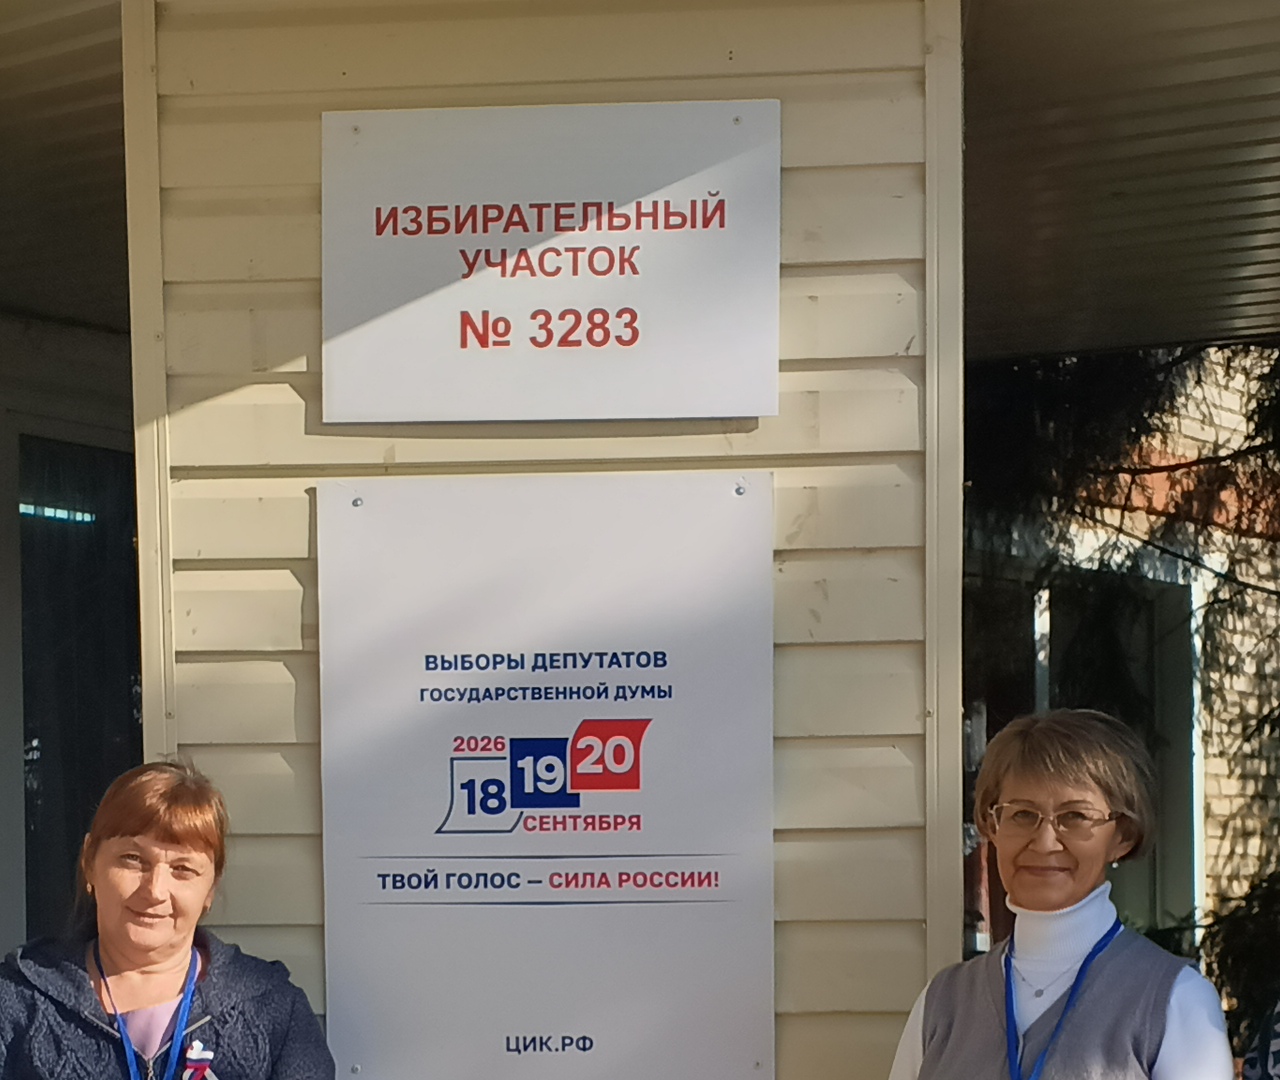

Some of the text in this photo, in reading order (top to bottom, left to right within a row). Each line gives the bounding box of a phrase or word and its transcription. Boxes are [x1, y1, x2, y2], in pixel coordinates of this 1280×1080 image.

[375, 190, 726, 236] ИЗБИРАТЕЛЬНЫЙ
[459, 245, 641, 279] УЧАСТОК
[460, 307, 640, 349] № 3283
[424, 650, 668, 672] ВЫБОРЫ ДЕПУТАТОВ
[420, 682, 673, 703] ГОСУДАРСТВЕННОЙ ДУМЫ
[452, 735, 506, 753] 2026
[460, 735, 635, 816] 18 19 20
[522, 814, 642, 832] СЕНТЯБРЯ
[377, 868, 438, 890] ТВОЙ
[445, 871, 522, 889] ГОЛОС
[548, 872, 612, 889] СИЛА
[618, 871, 720, 888] РОССИИ!
[505, 1035, 594, 1055] ЦИК.РФ
